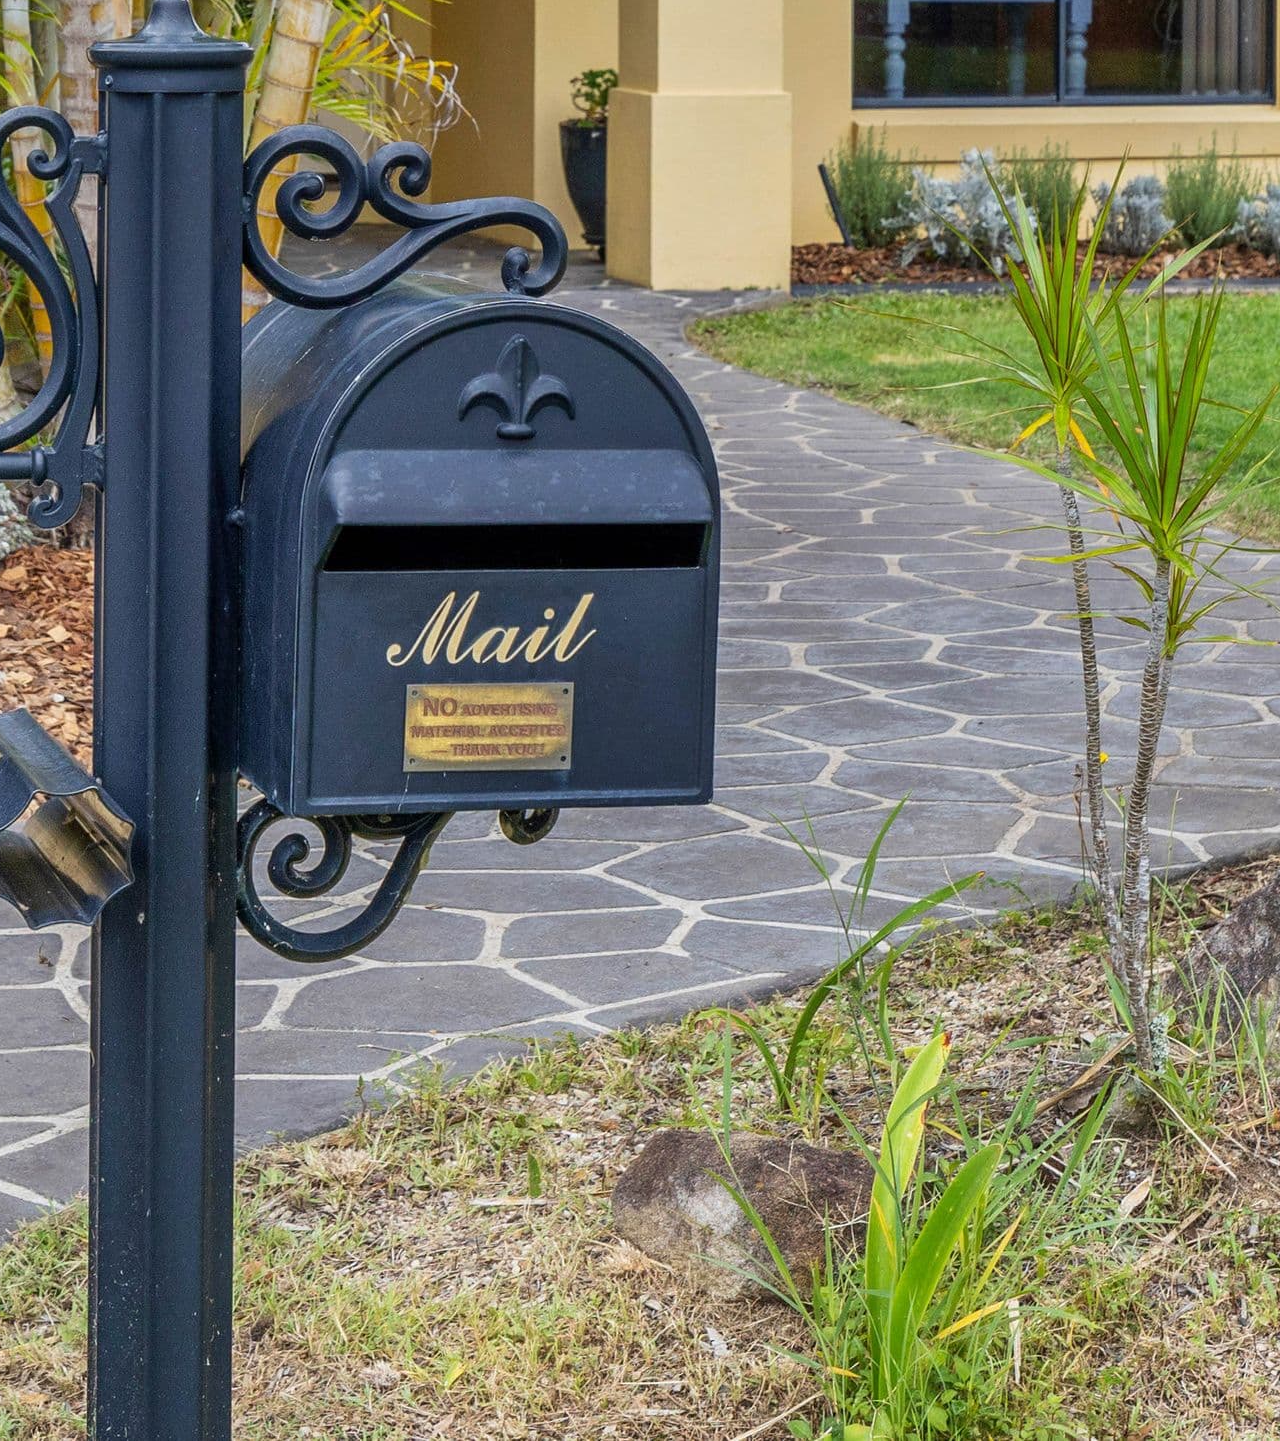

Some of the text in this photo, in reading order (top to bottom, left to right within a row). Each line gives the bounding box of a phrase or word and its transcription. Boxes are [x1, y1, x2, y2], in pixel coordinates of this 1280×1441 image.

[386, 590, 597, 667] Mail
[422, 697, 558, 717] NO ADVERTISING
[409, 724, 567, 738] MATERIAL ACCEPTED
[451, 743, 501, 757] THANK
